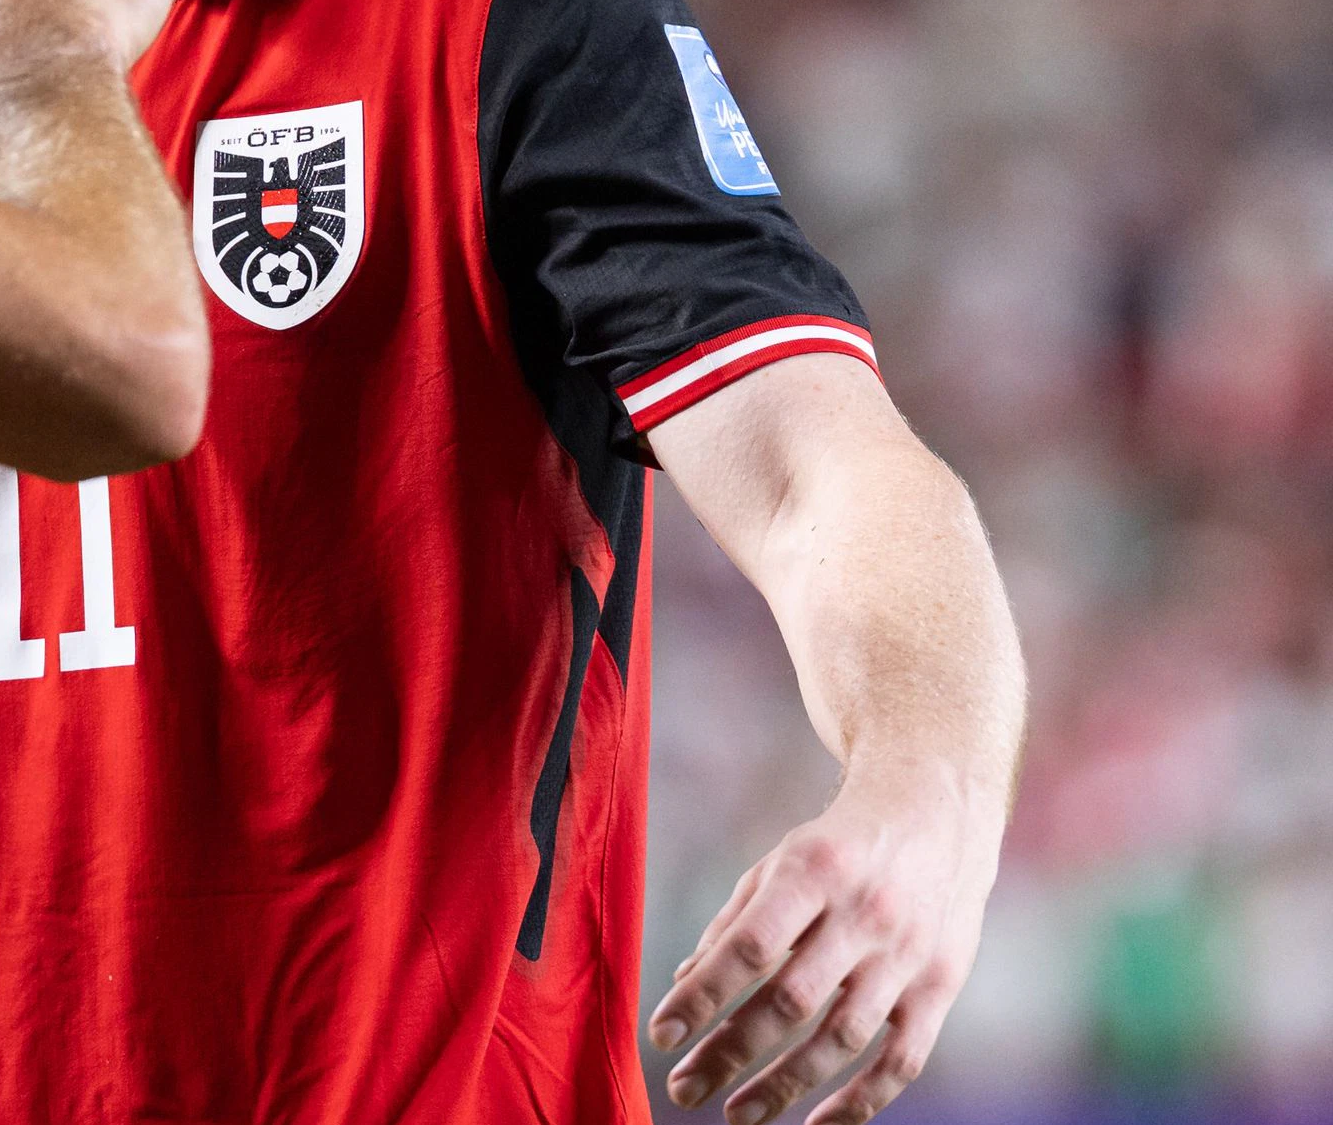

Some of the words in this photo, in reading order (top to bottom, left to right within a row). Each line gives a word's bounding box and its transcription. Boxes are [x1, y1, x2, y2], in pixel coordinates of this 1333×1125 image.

[220, 137, 242, 146] SEIT
[247, 125, 315, 148] ÖFB
[319, 126, 341, 136] 1904
